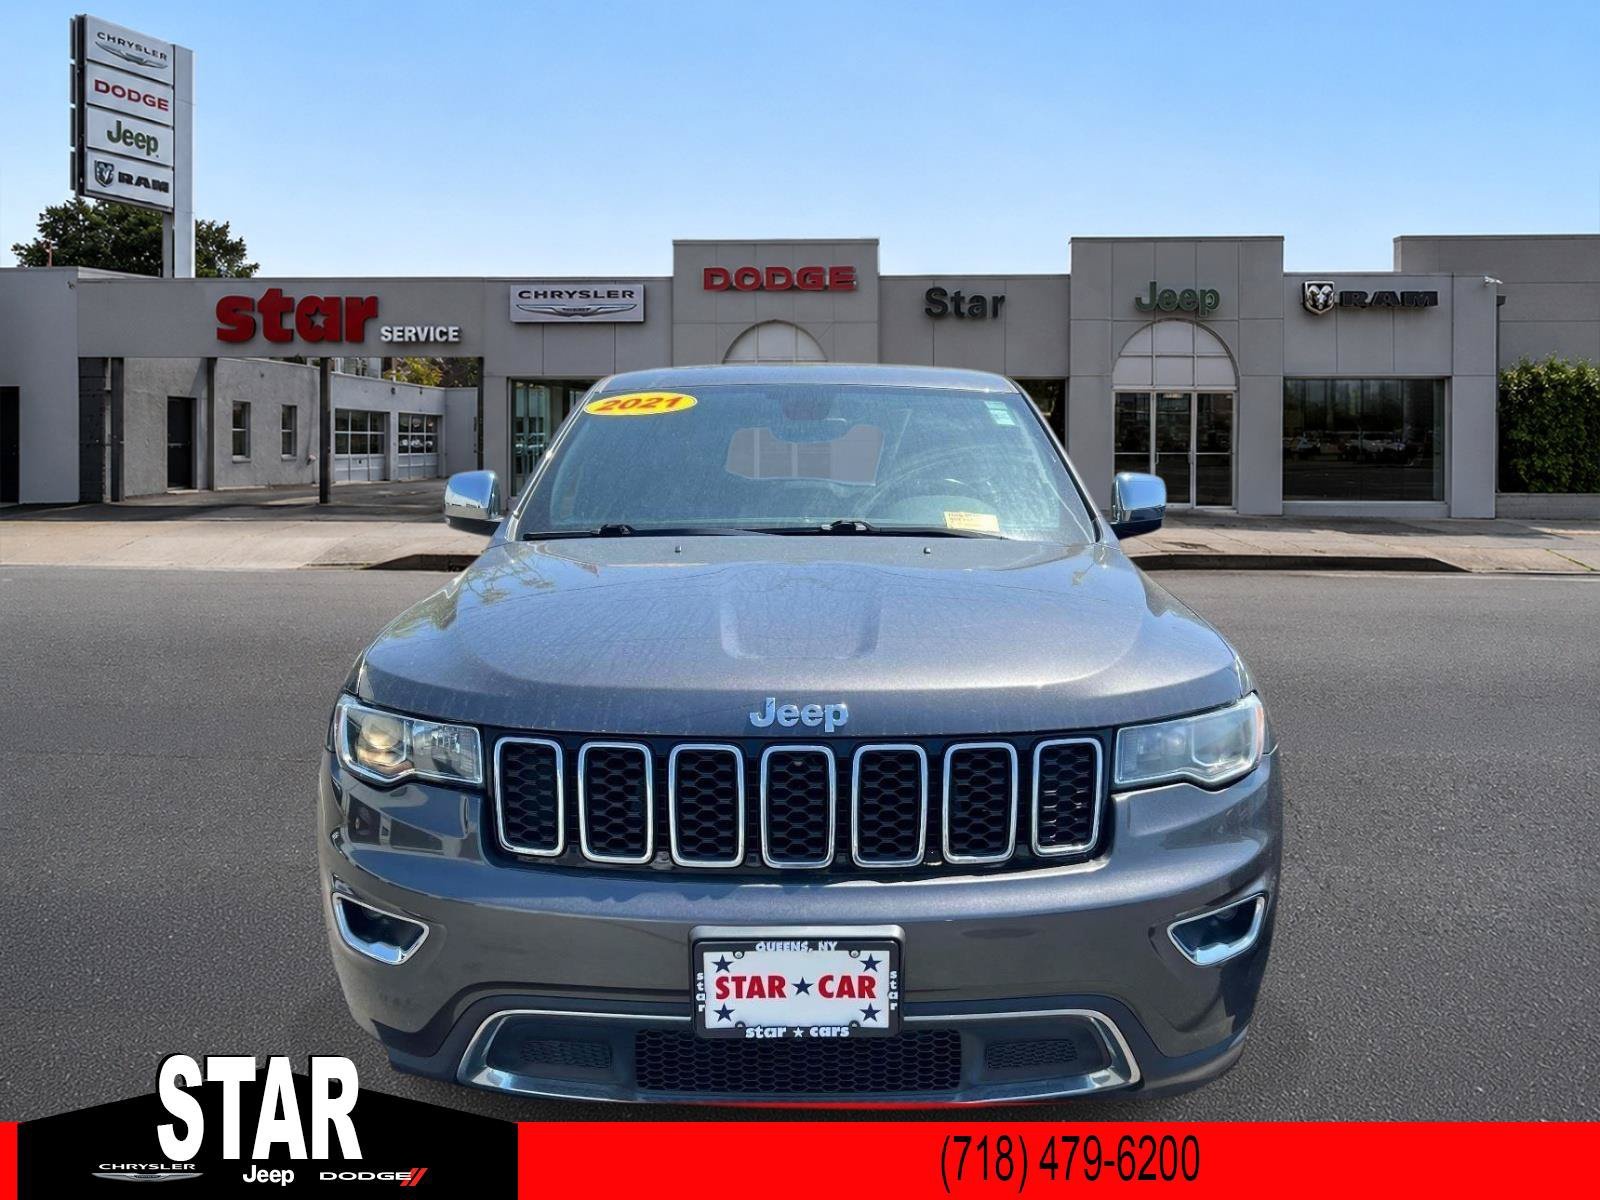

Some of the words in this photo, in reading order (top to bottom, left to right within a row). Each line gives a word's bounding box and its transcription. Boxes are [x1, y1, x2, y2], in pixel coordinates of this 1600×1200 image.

[97, 31, 167, 61] CHRYSLER
[94, 79, 169, 111] DODGE
[106, 120, 159, 156] Jeep
[118, 171, 169, 193] RAM
[703, 266, 857, 292] DODGE
[518, 289, 635, 300] CHRYSLER
[924, 287, 1006, 320] Star
[1134, 281, 1220, 316] Jeep
[1339, 290, 1439, 308] RAM
[216, 287, 379, 343] star
[380, 326, 461, 343] SERVICE
[597, 396, 683, 412] 2021
[750, 697, 848, 733] Jeep
[755, 941, 813, 953] QUEENS,
[818, 941, 838, 951] NY
[696, 972, 706, 1012] star
[715, 975, 787, 1000] STAR
[818, 974, 877, 999] CAR
[888, 970, 898, 1011] star
[745, 1025, 787, 1038] star
[809, 1025, 850, 1038] cars
